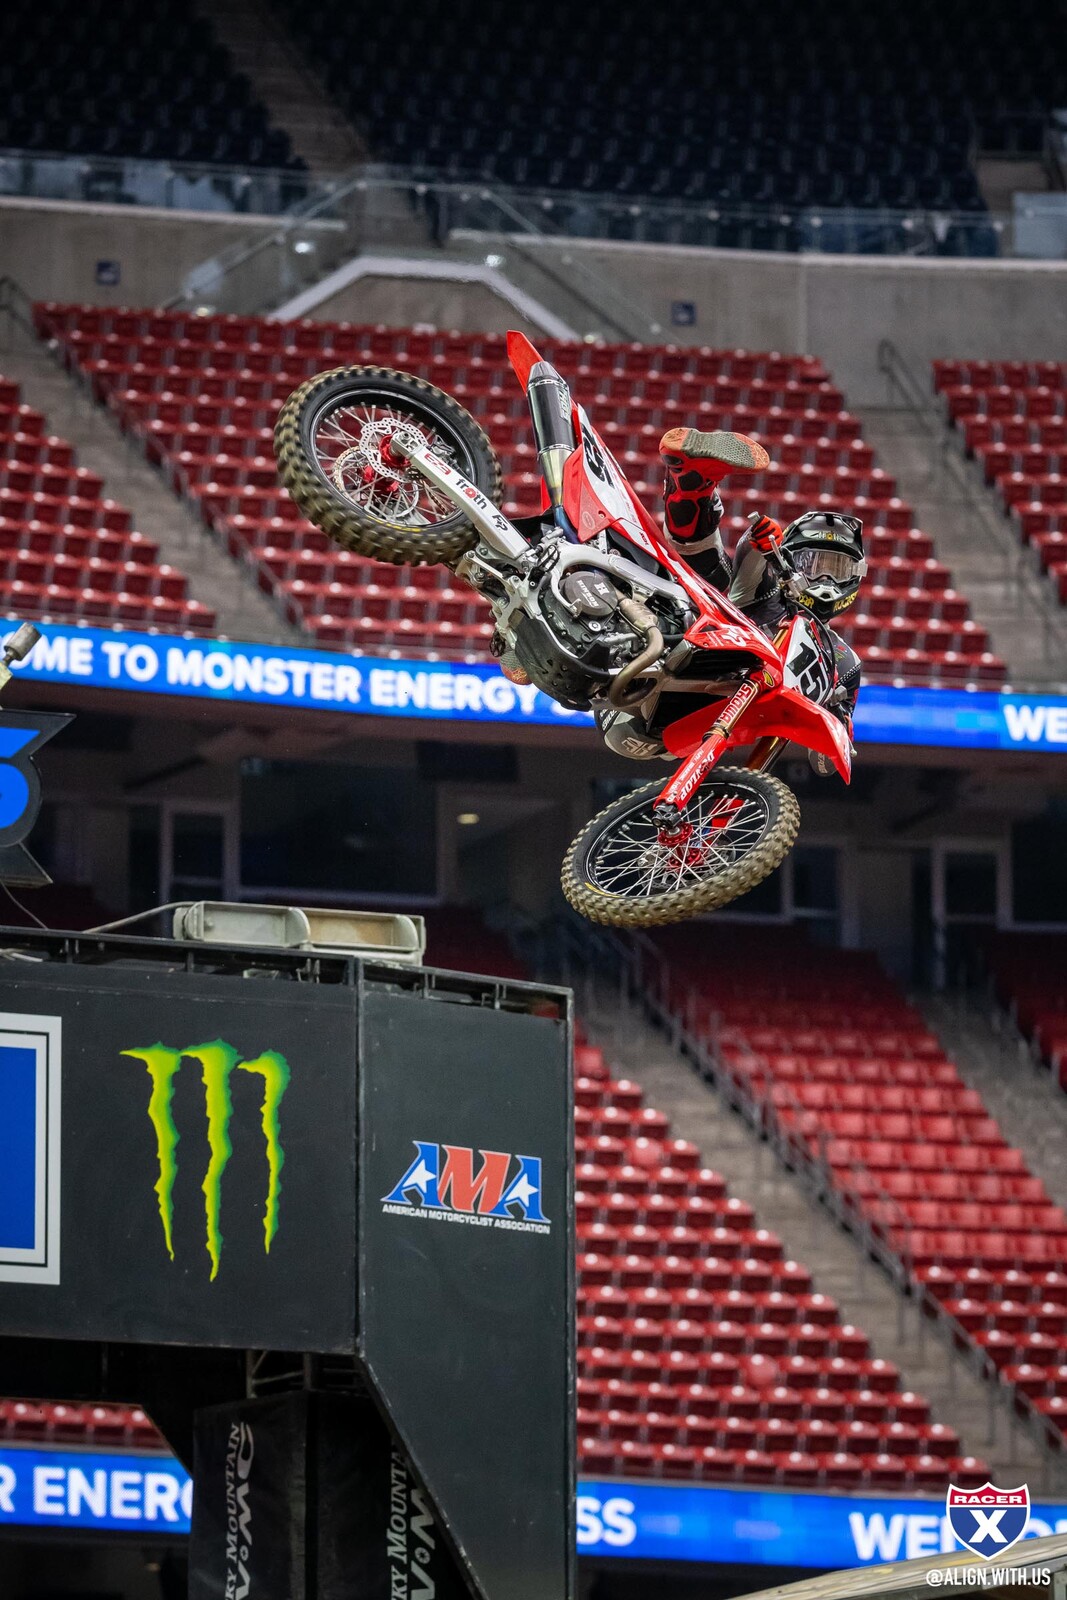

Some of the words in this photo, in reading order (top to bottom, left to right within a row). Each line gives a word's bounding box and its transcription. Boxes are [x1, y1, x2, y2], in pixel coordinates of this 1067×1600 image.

[456, 478, 488, 510] froth
[101, 640, 159, 682] TO
[166, 647, 362, 704] MONSTER
[369, 668, 539, 715] ENERGY
[719, 681, 752, 726] SHOWA
[1003, 704, 1067, 743] WE
[380, 1140, 551, 1223] AMA
[382, 1203, 428, 1219] AMERICAN
[427, 1210, 494, 1227] MOTORCYCLIST
[493, 1219, 551, 1235] ASSOCIATION
[225, 1423, 241, 1563] MOUNTAIN
[386, 1451, 408, 1564] MOUNTA
[576, 1496, 637, 1547] SS
